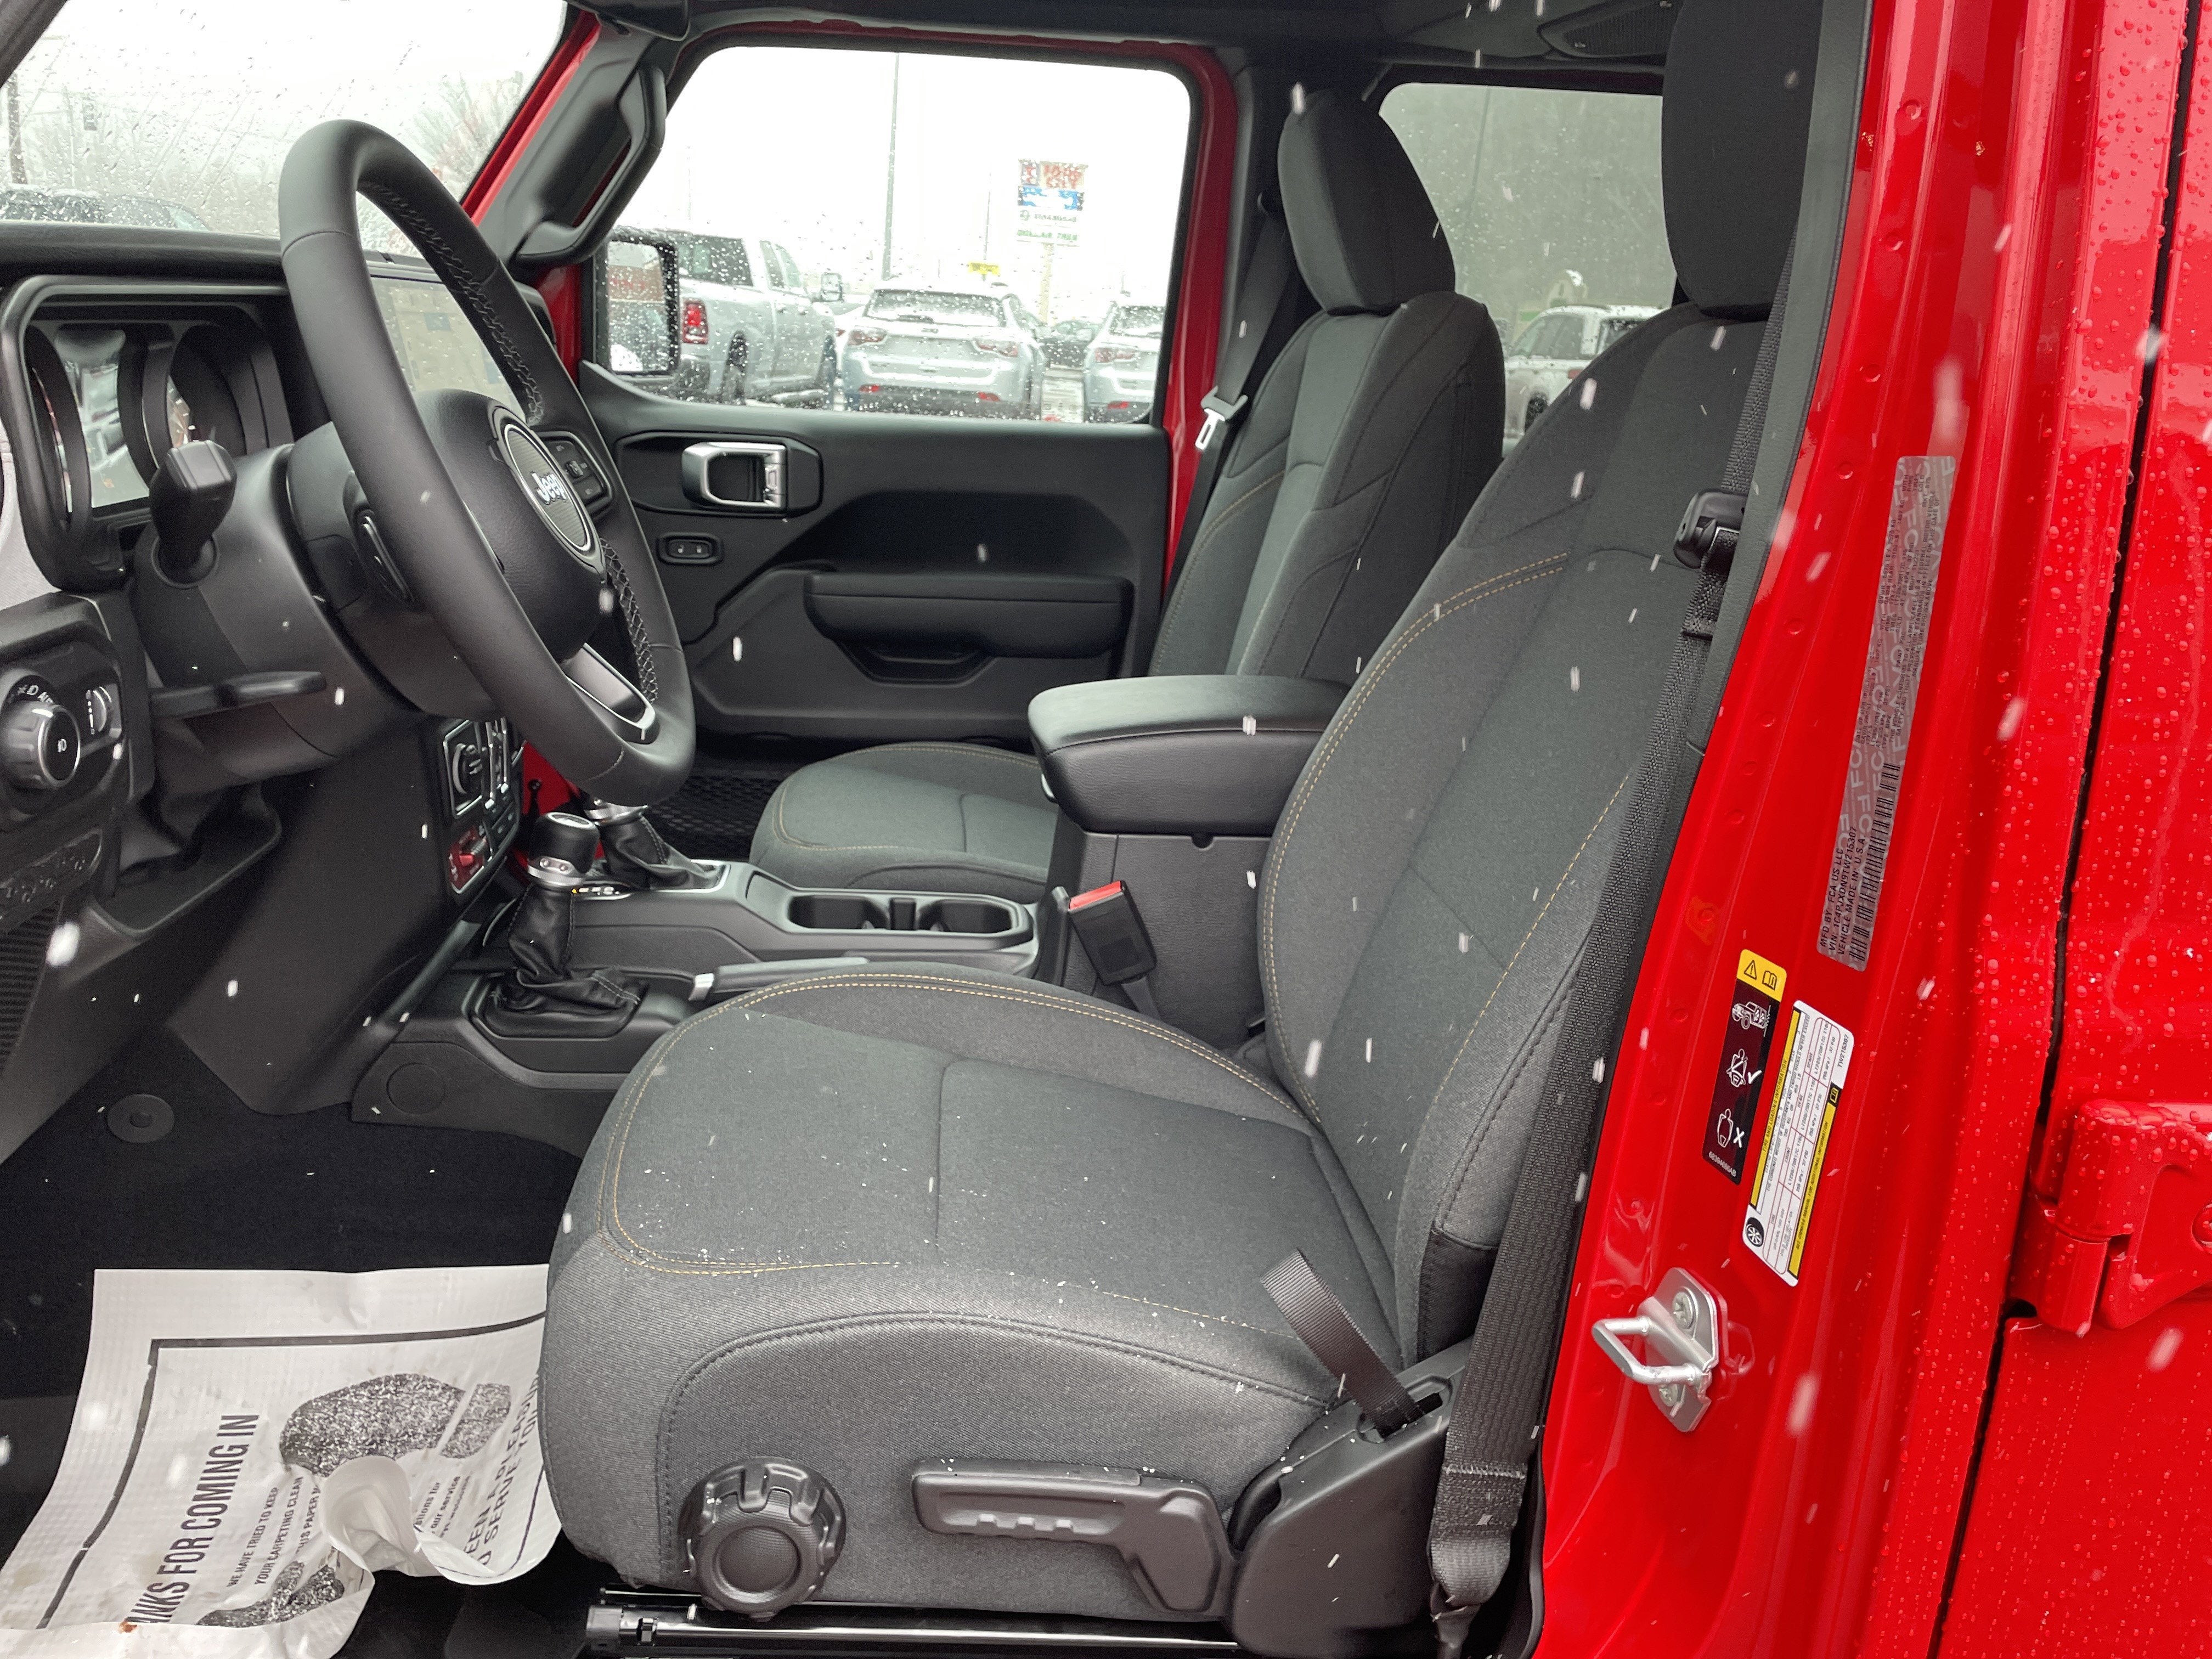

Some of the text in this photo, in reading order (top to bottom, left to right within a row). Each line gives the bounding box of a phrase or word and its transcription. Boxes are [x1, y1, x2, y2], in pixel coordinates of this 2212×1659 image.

[531, 472, 567, 505] Jeep
[1927, 543, 1933, 552] ON
[1903, 652, 1909, 662] TO
[1834, 848, 1843, 865] LLC
[1831, 867, 1839, 881] US
[1827, 884, 1836, 903] FCA
[1820, 925, 1829, 947] MFD
[1837, 915, 1850, 955] VEHICLE
[1845, 884, 1856, 913] MADE
[1836, 1033, 1849, 1069] TW215307
[1768, 1098, 1778, 1125] LOADING
[1774, 1058, 1787, 1099] INFORMATION
[216, 1414, 259, 1437] IN
[181, 1444, 250, 1530] COMING
[431, 1514, 443, 1528] our
[440, 1476, 461, 1511] service
[484, 1458, 521, 1544] SERVE
[303, 1496, 319, 1529] PAPER
[227, 1487, 279, 1587] WE HAVE TRIED TO KEEP
[254, 1476, 303, 1584] YOUR CARPETING CLEAN
[156, 1537, 214, 1575] FOR
